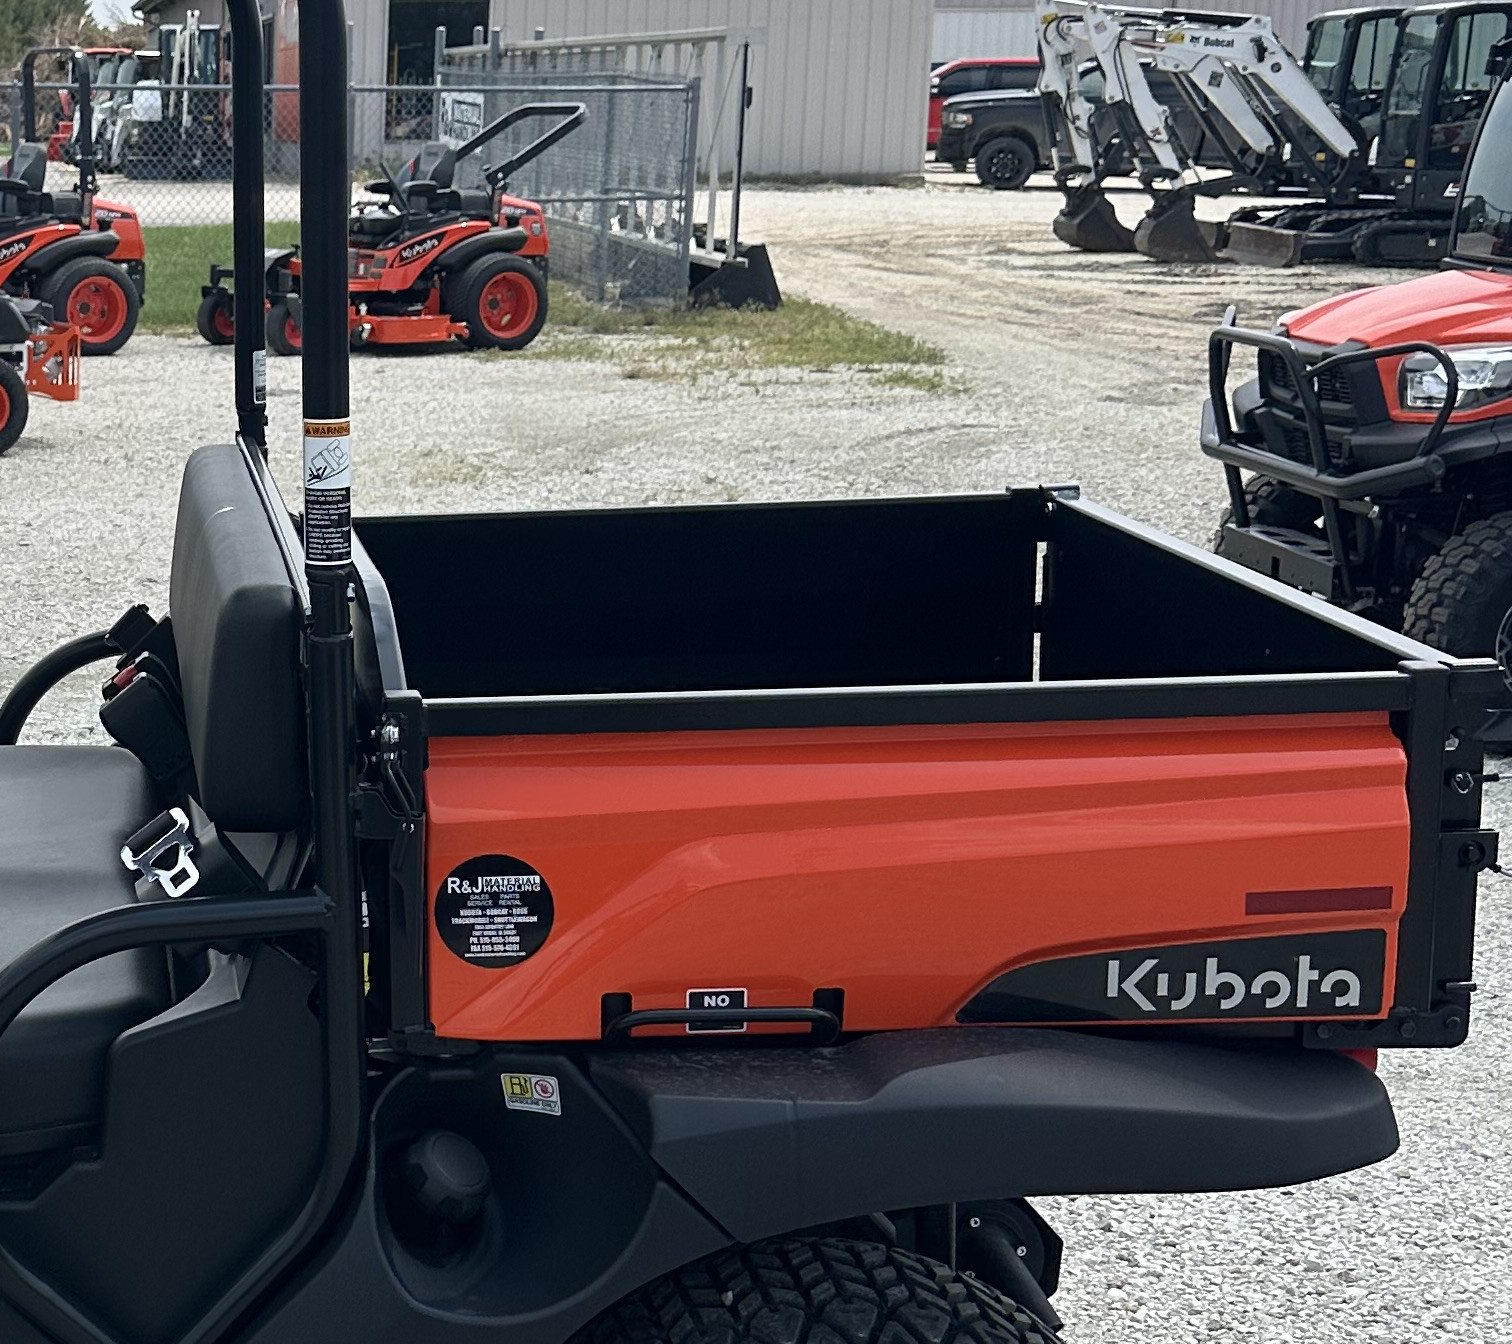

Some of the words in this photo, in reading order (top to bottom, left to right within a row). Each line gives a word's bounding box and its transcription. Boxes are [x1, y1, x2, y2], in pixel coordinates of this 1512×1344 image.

[1203, 37, 1234, 48] Bobcat
[447, 876, 483, 894] R&J
[484, 877, 538, 885] MATERIAL
[483, 884, 541, 892] HANDLING
[1106, 954, 1361, 1012] Kubota
[703, 995, 730, 1007] NO
